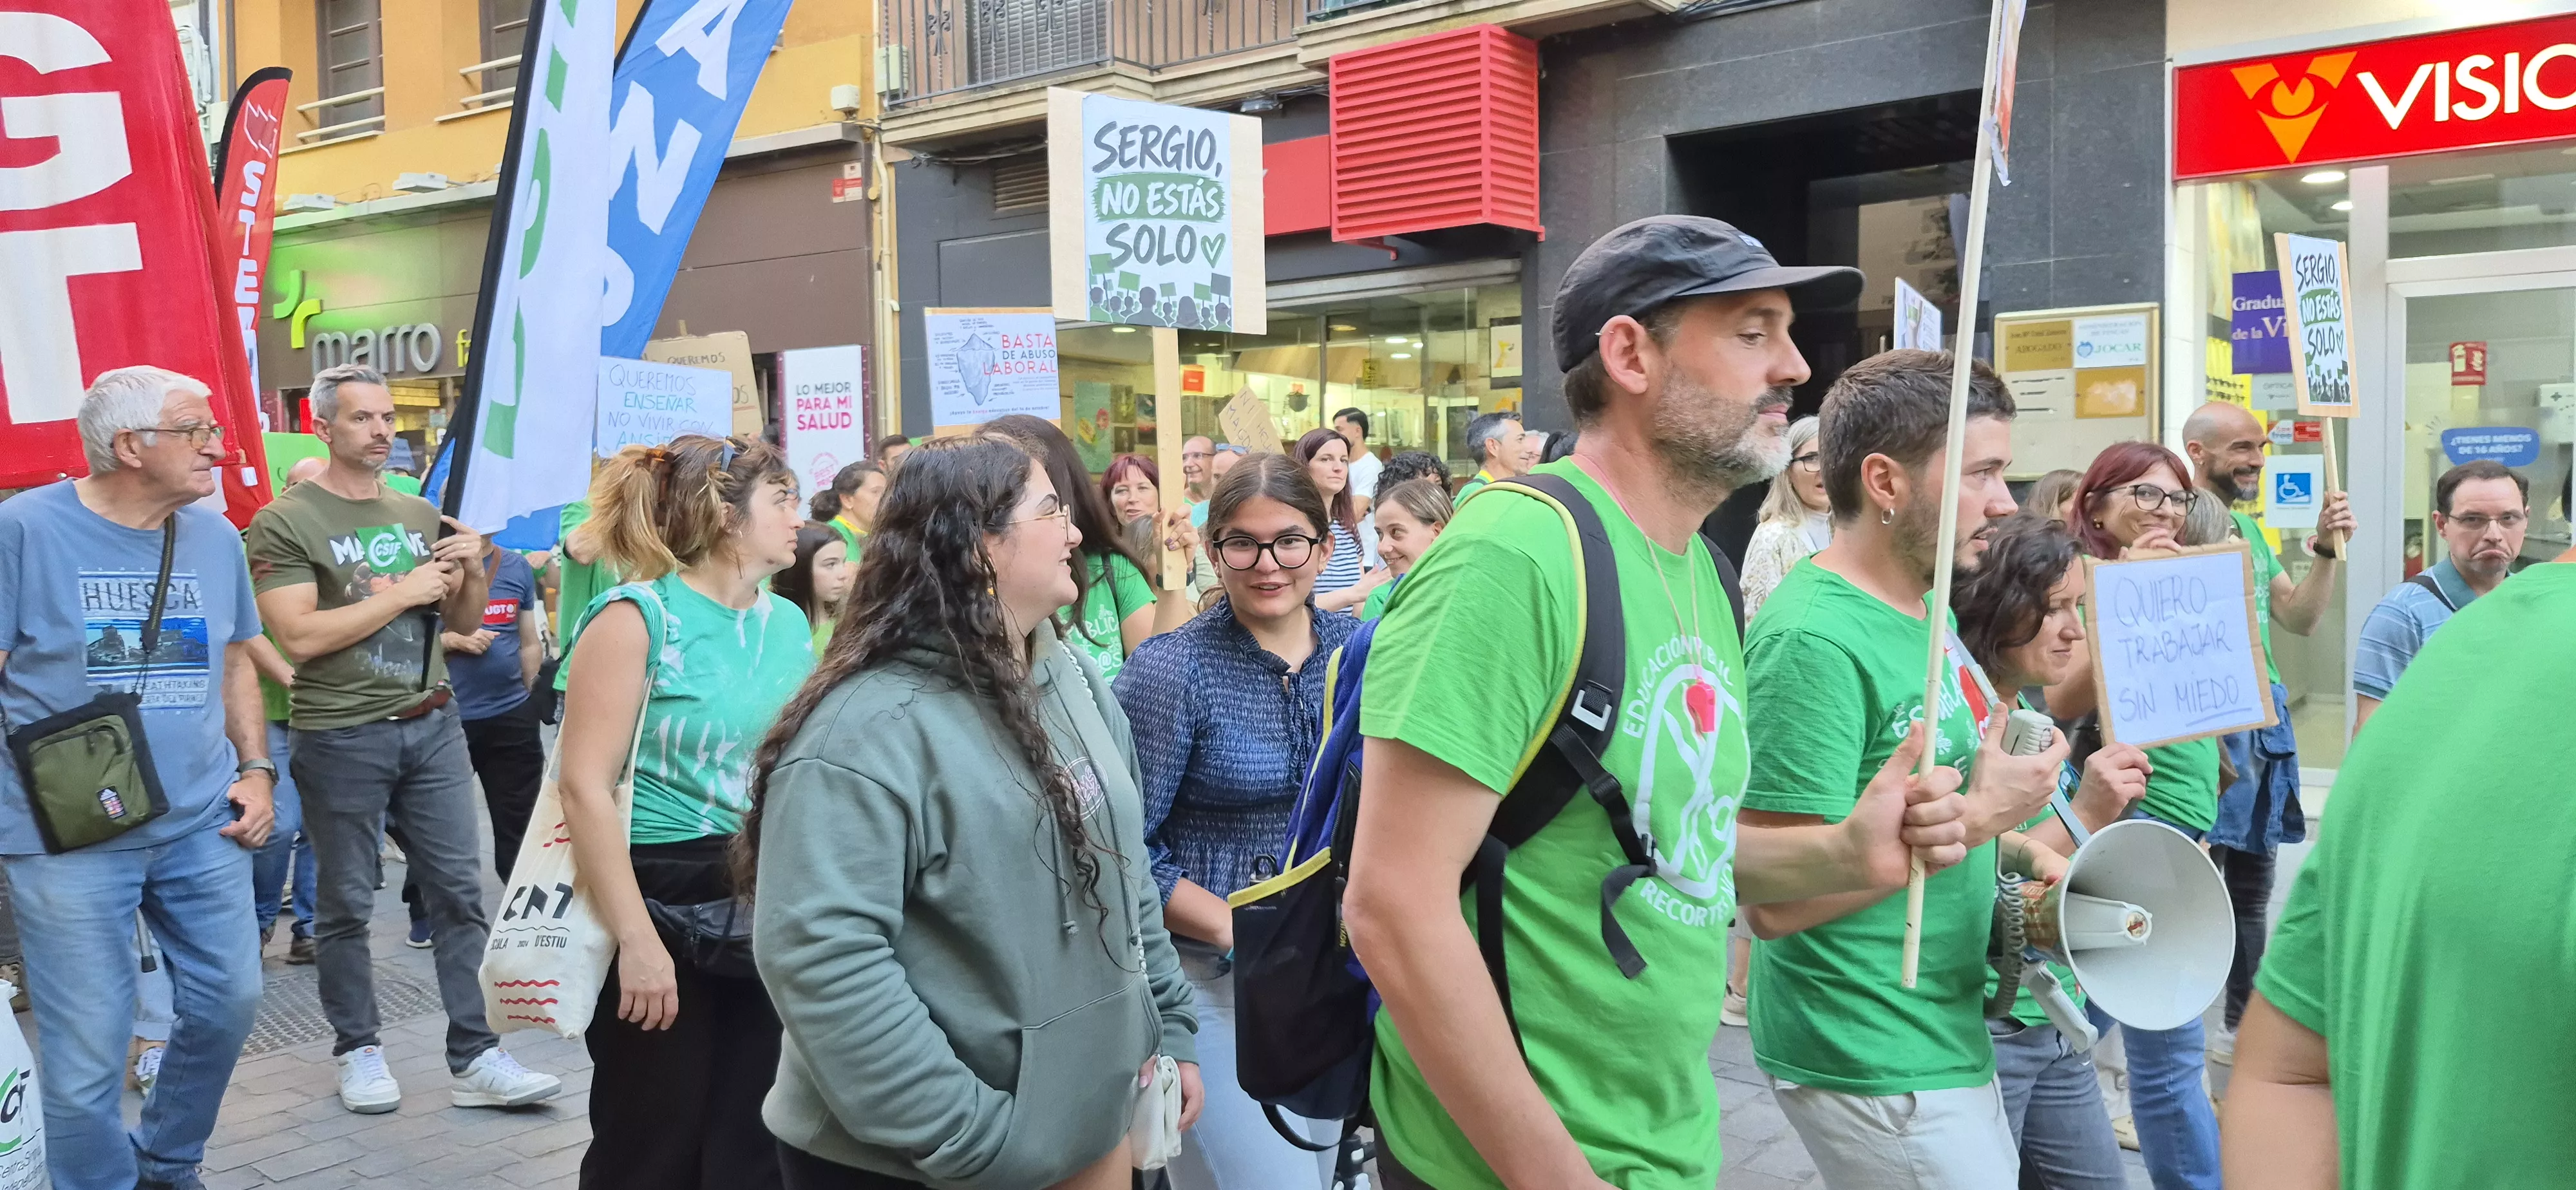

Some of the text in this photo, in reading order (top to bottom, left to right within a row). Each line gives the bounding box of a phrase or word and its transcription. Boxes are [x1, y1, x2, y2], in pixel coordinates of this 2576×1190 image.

[2356, 42, 2576, 130] VISIO
[1092, 120, 1222, 178] SERGIO,
[1101, 178, 1220, 218] NO ESTÁS
[1106, 223, 1197, 268] SOLO
[2295, 253, 2338, 292] SERGIO,
[2302, 290, 2340, 325] NO ESTÁS
[1001, 333, 1055, 349] BASTA
[2232, 316, 2290, 340] de la Vi
[2308, 325, 2336, 357] SOLO
[312, 323, 441, 377] marro
[1002, 350, 1056, 360] DE ABUSO
[2094, 343, 2142, 354] JOCAR
[609, 364, 697, 397] QUEREMOS
[982, 359, 1058, 376] LABORAL
[623, 391, 697, 413] ENSEÑAR
[796, 381, 852, 396] LO MEJOR
[796, 395, 853, 411] PARA MI
[607, 411, 630, 428] NO
[638, 412, 676, 431] VIVIR
[797, 411, 853, 431] SALUD
[2492, 433, 2532, 443] MENOS
[374, 541, 402, 558] CSIF
[2114, 574, 2207, 627] QUIERO
[2117, 619, 2232, 668] TRABAJAR
[2118, 674, 2239, 722] SIN MIEDO
[502, 882, 574, 921] CNT
[535, 934, 567, 949] D'ESTIU
